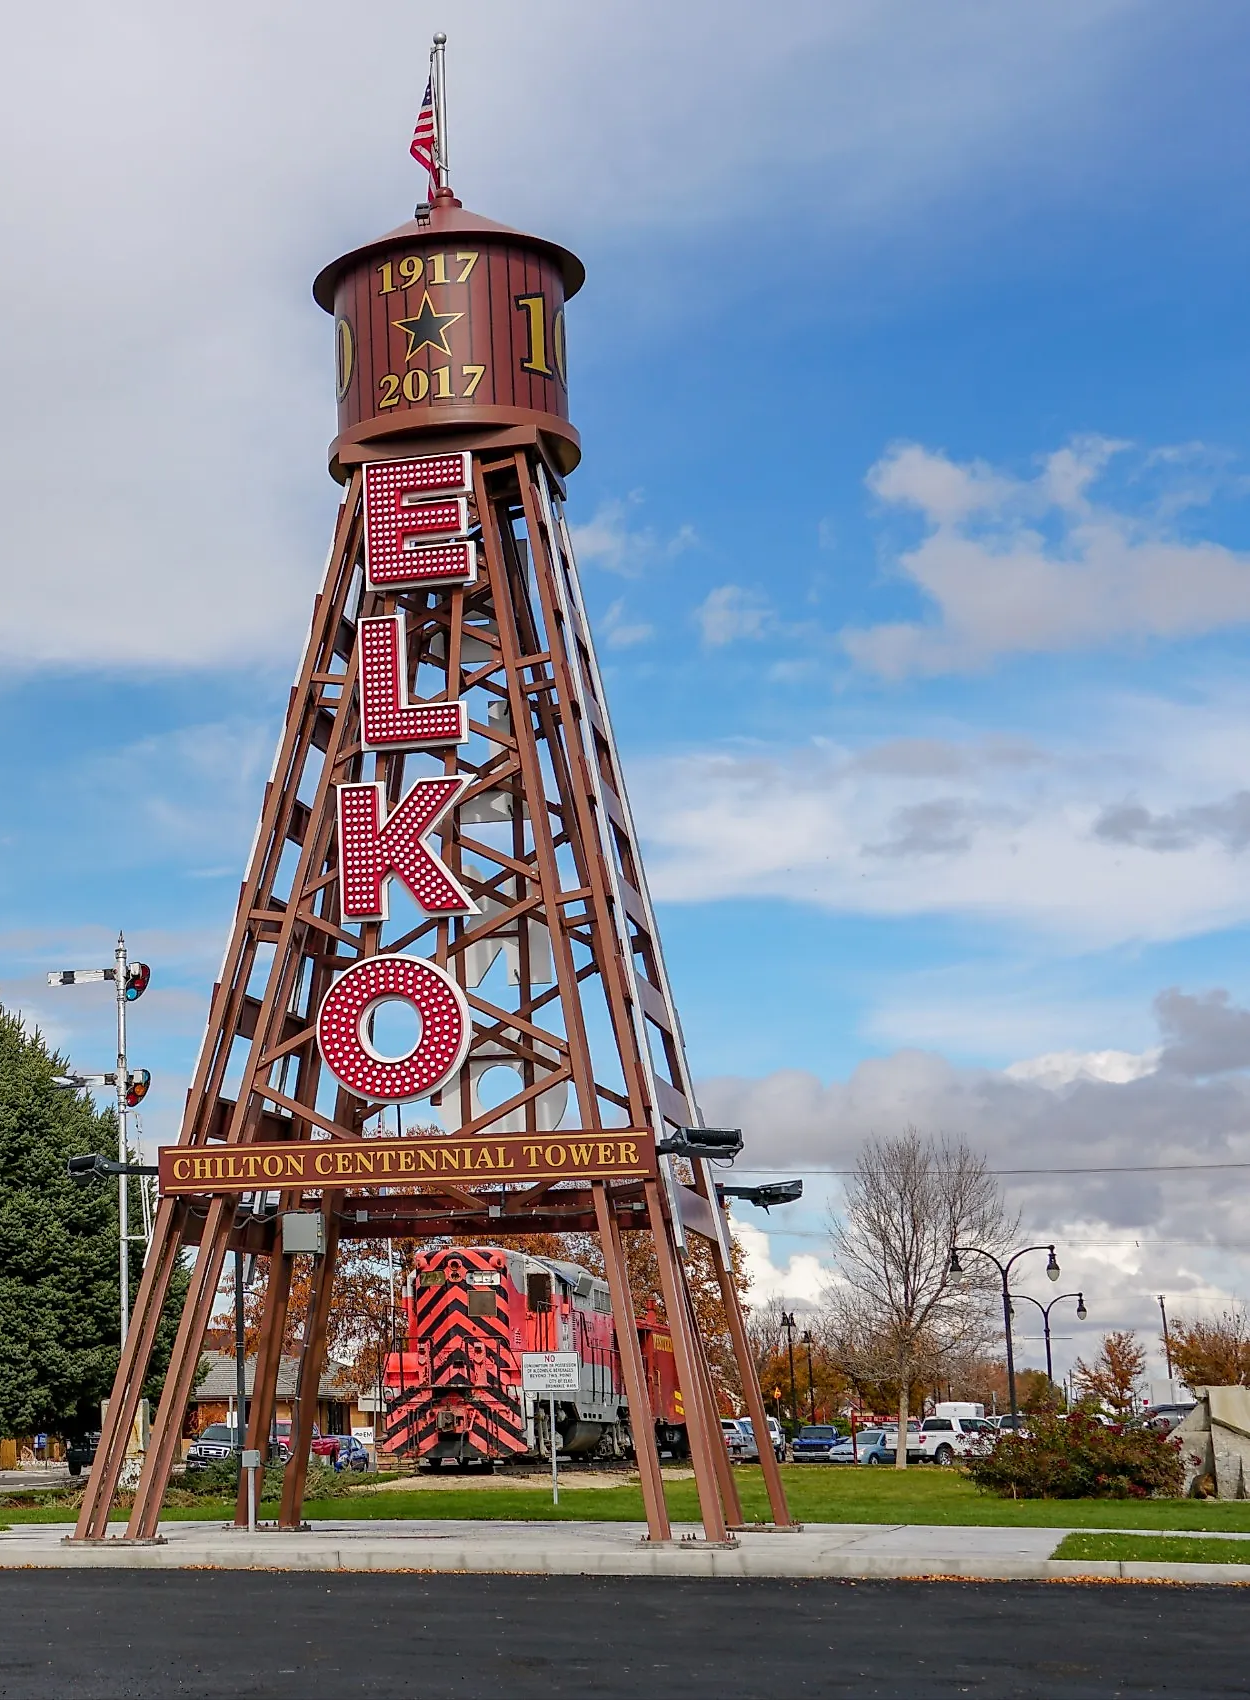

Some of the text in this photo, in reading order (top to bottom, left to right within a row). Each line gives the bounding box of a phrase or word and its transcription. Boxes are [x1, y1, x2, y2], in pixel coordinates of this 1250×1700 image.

[377, 251, 480, 296] 1917
[378, 364, 486, 410] 2017
[316, 451, 482, 1106] ELKO
[172, 1141, 640, 1181] CHILTON CENTENNIAL TOWER
[544, 1354, 556, 1363] NO
